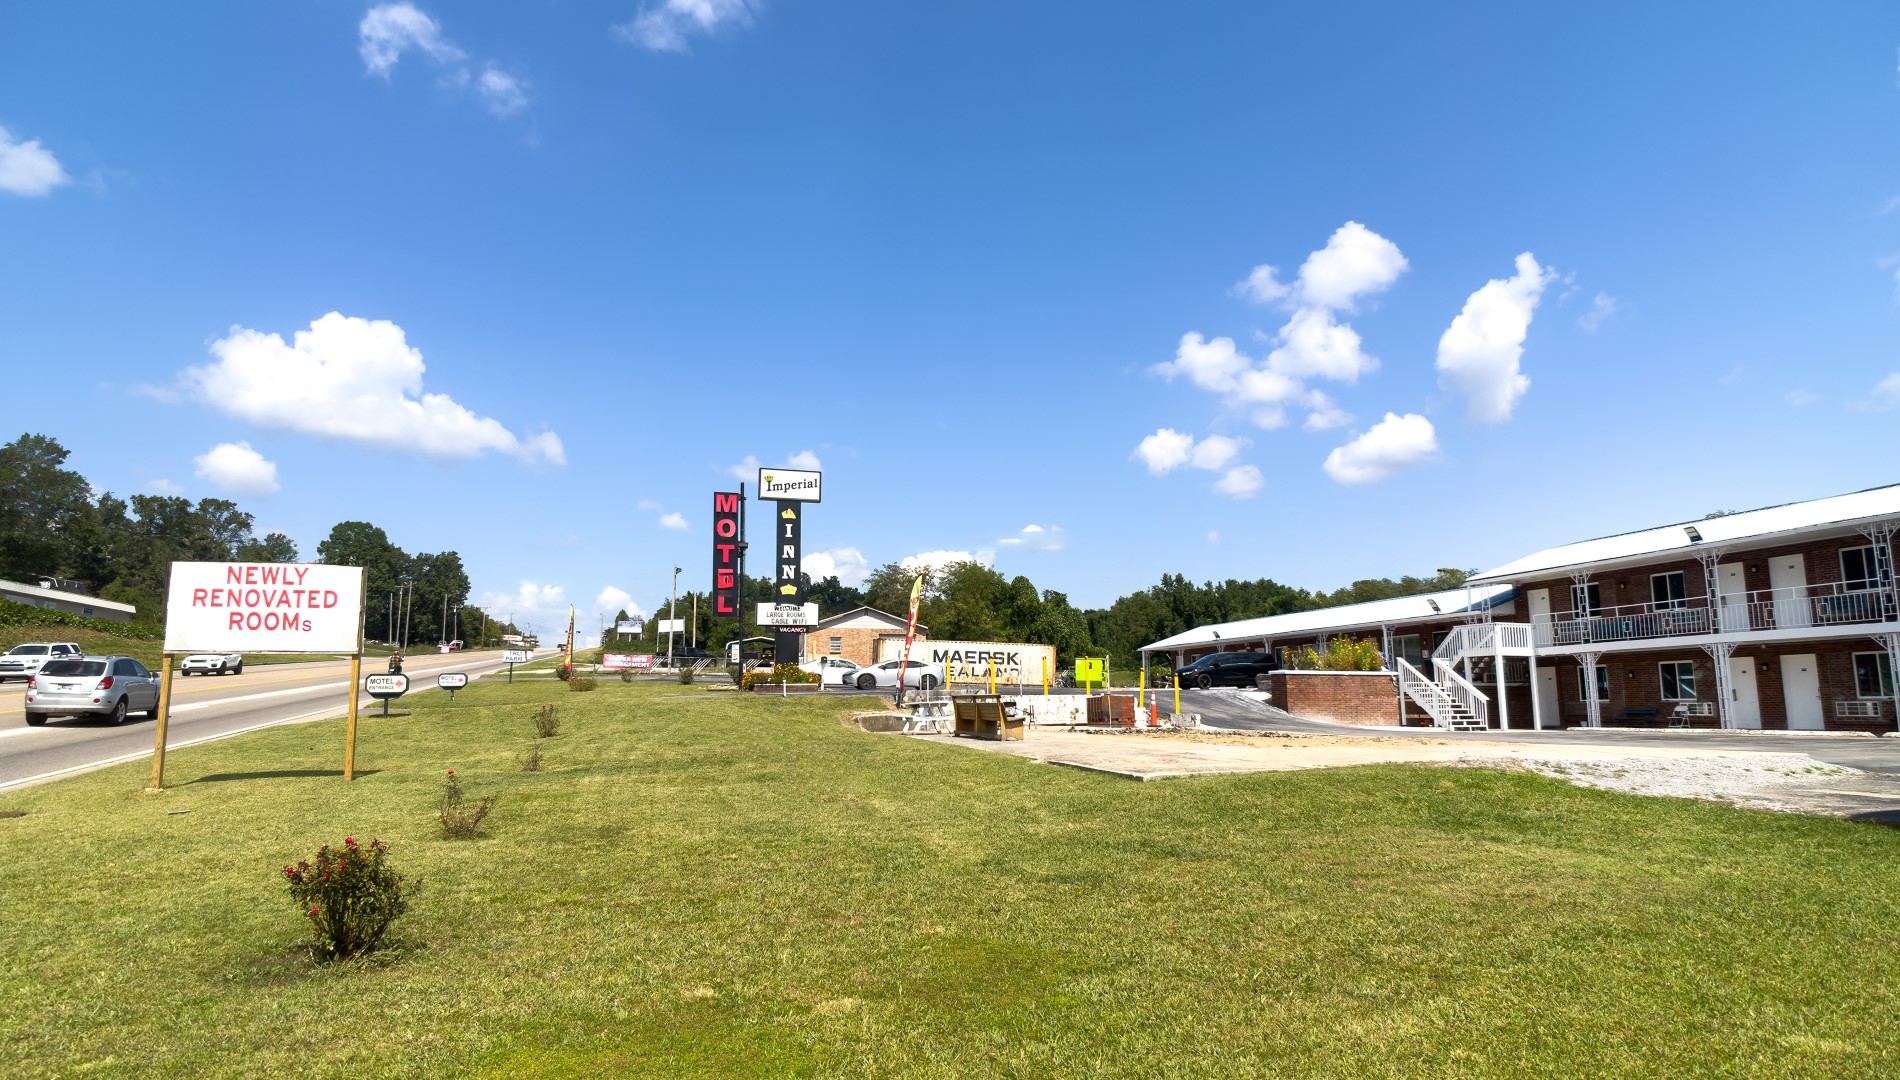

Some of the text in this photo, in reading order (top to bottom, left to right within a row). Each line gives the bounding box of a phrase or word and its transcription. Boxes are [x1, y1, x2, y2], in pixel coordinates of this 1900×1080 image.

[766, 478, 818, 493] Imperial
[716, 494, 738, 613] MOTEL
[782, 523, 797, 580] INN
[226, 566, 309, 585] NEWLY
[192, 588, 338, 609] RENOVATED
[933, 649, 1019, 665] MAERSK
